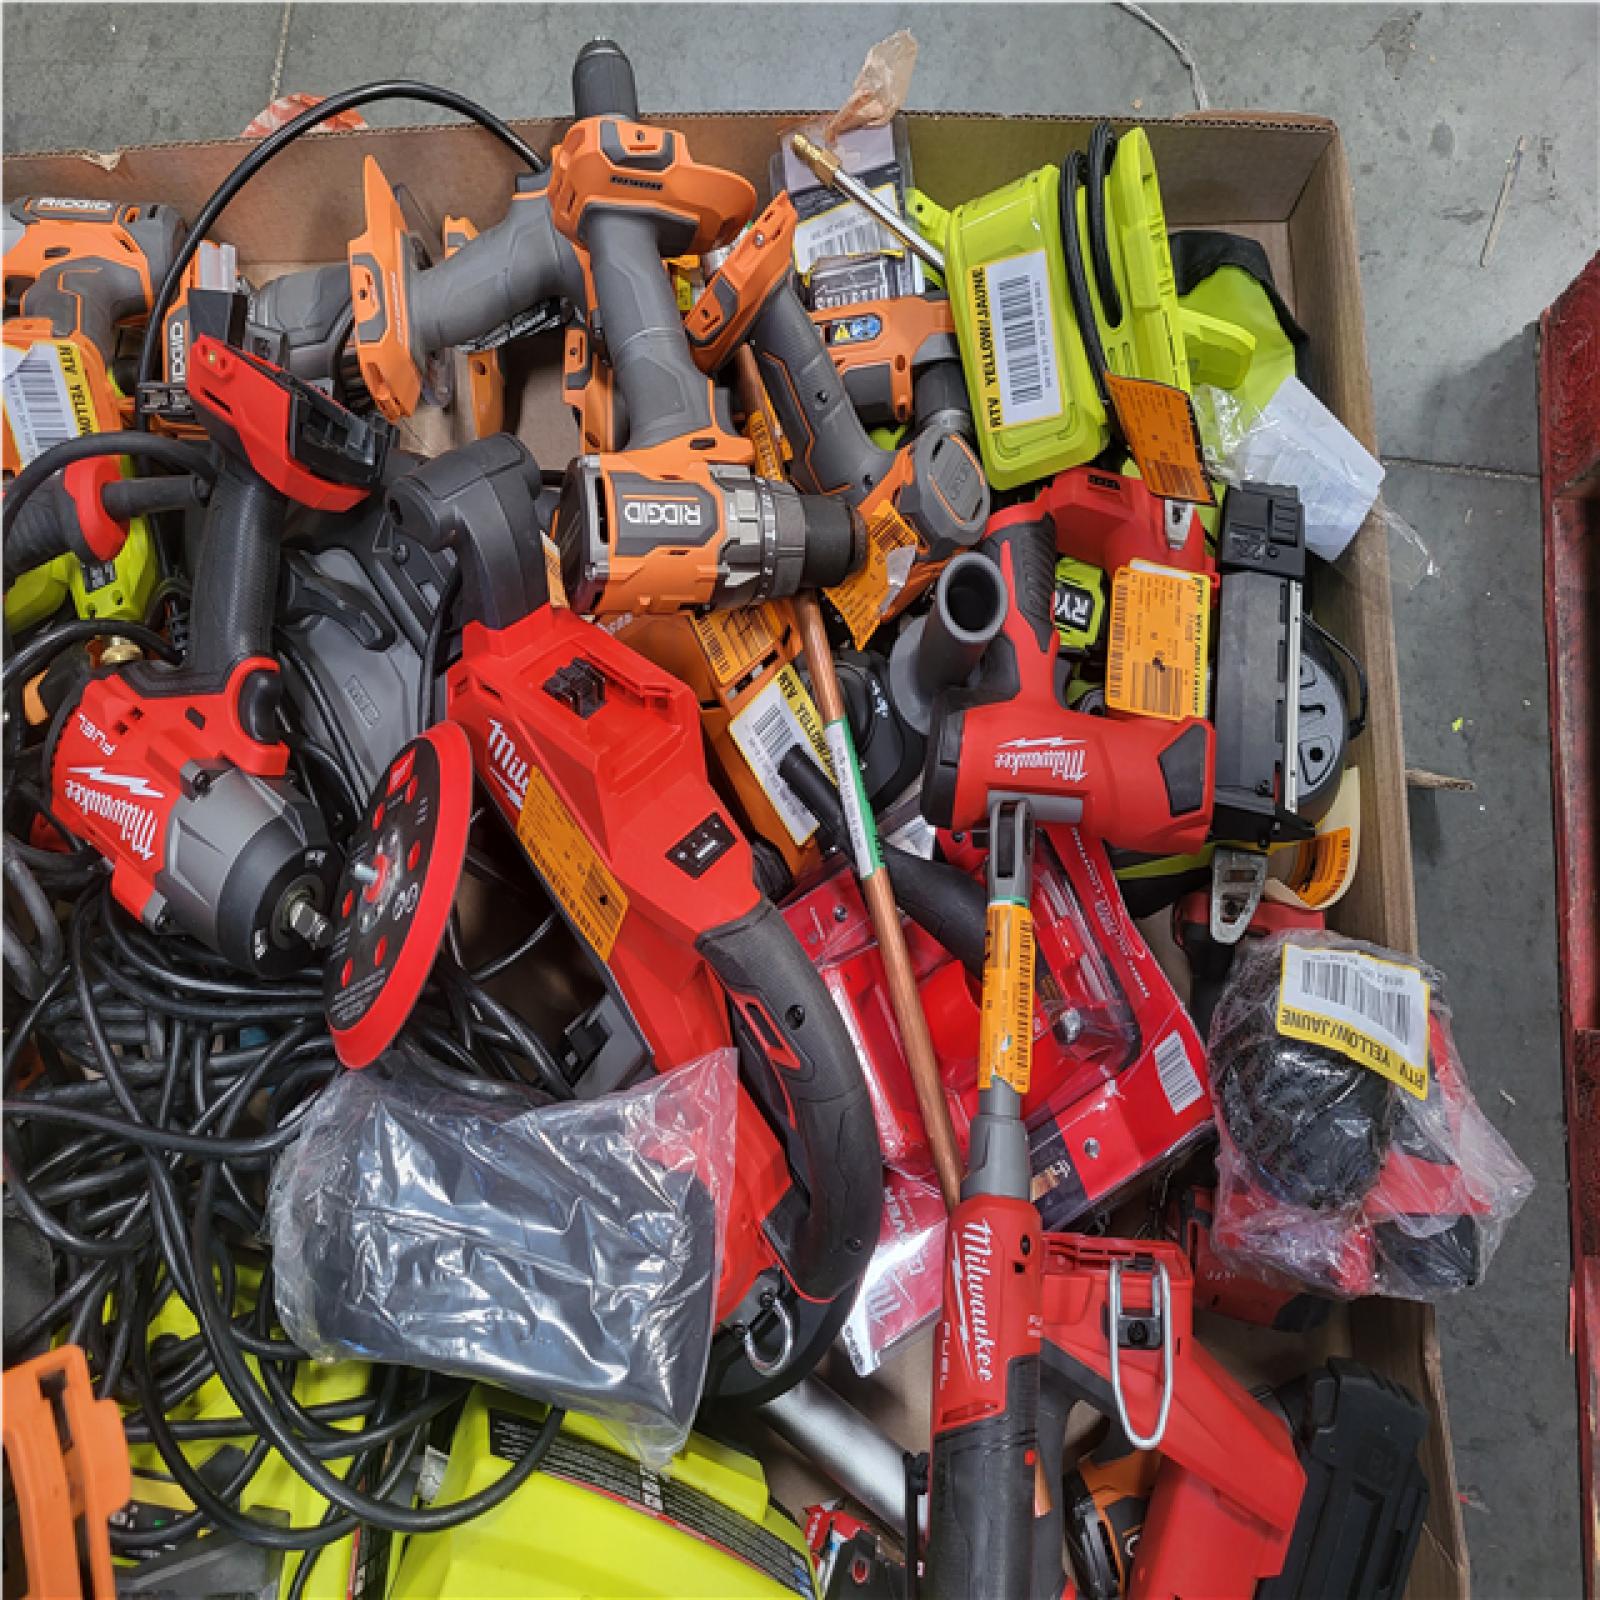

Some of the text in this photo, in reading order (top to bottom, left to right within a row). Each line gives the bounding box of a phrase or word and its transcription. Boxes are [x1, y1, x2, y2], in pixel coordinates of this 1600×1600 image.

[624, 501, 701, 528] RIDGID
[993, 749, 1089, 783] Milwaukee
[64, 779, 158, 861] Milwaukee
[1398, 1062, 1426, 1092] RTV
[962, 1216, 998, 1382] Milwaukee
[939, 1320, 952, 1392] FUEL
